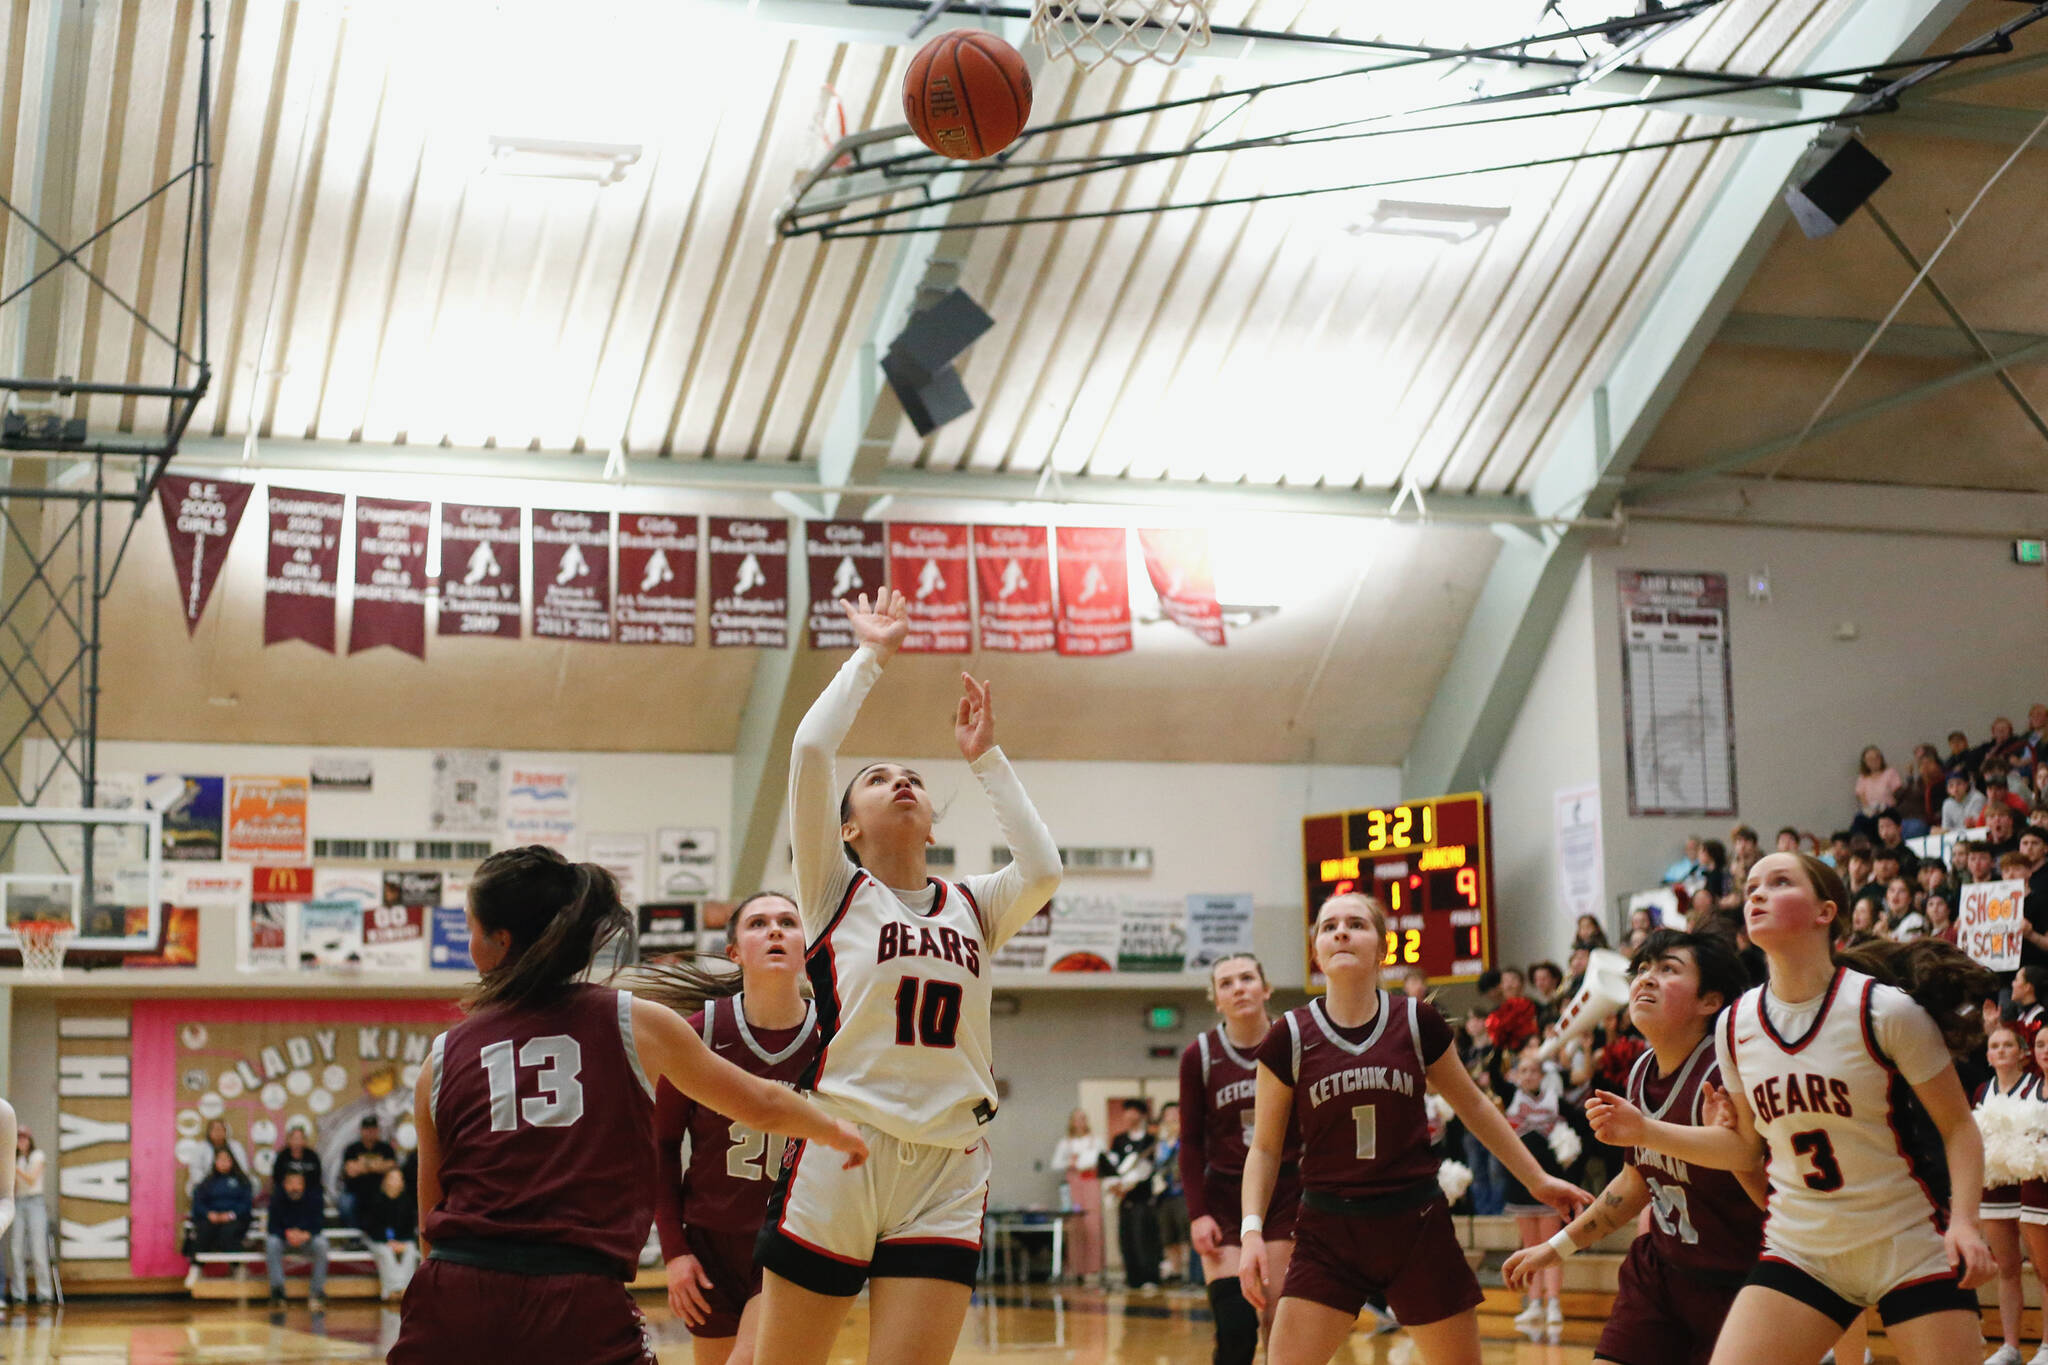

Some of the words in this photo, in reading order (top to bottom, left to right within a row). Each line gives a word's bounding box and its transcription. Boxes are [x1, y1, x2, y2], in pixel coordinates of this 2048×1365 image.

[931, 74, 959, 118] THE
[180, 498, 227, 519] 2000
[461, 507, 502, 526] Girls
[551, 511, 592, 530] Girls
[177, 515, 228, 536] GIRLS
[637, 516, 678, 535] Girls
[728, 520, 770, 540] Girls
[825, 525, 866, 543] Girls
[282, 561, 322, 580] GIRLS
[371, 569, 412, 587] GIRLS
[445, 580, 500, 601] Region
[1367, 805, 1432, 851] 3:21
[1391, 880, 1401, 910] 1
[1456, 867, 1477, 907] 9
[1965, 890, 2023, 926] SHOOT
[876, 920, 981, 979] BEARS
[1468, 925, 1480, 956] 1
[893, 974, 964, 1049] 10
[235, 1028, 337, 1091] LADY
[358, 1026, 428, 1064] KIN
[480, 1033, 584, 1133] 13
[1215, 1078, 1258, 1110] KETCH
[1308, 1065, 1415, 1110] KETCHIKAN
[1752, 1072, 1854, 1125] BEARS
[1351, 1103, 1377, 1160] 1
[1790, 1128, 1845, 1193] 3
